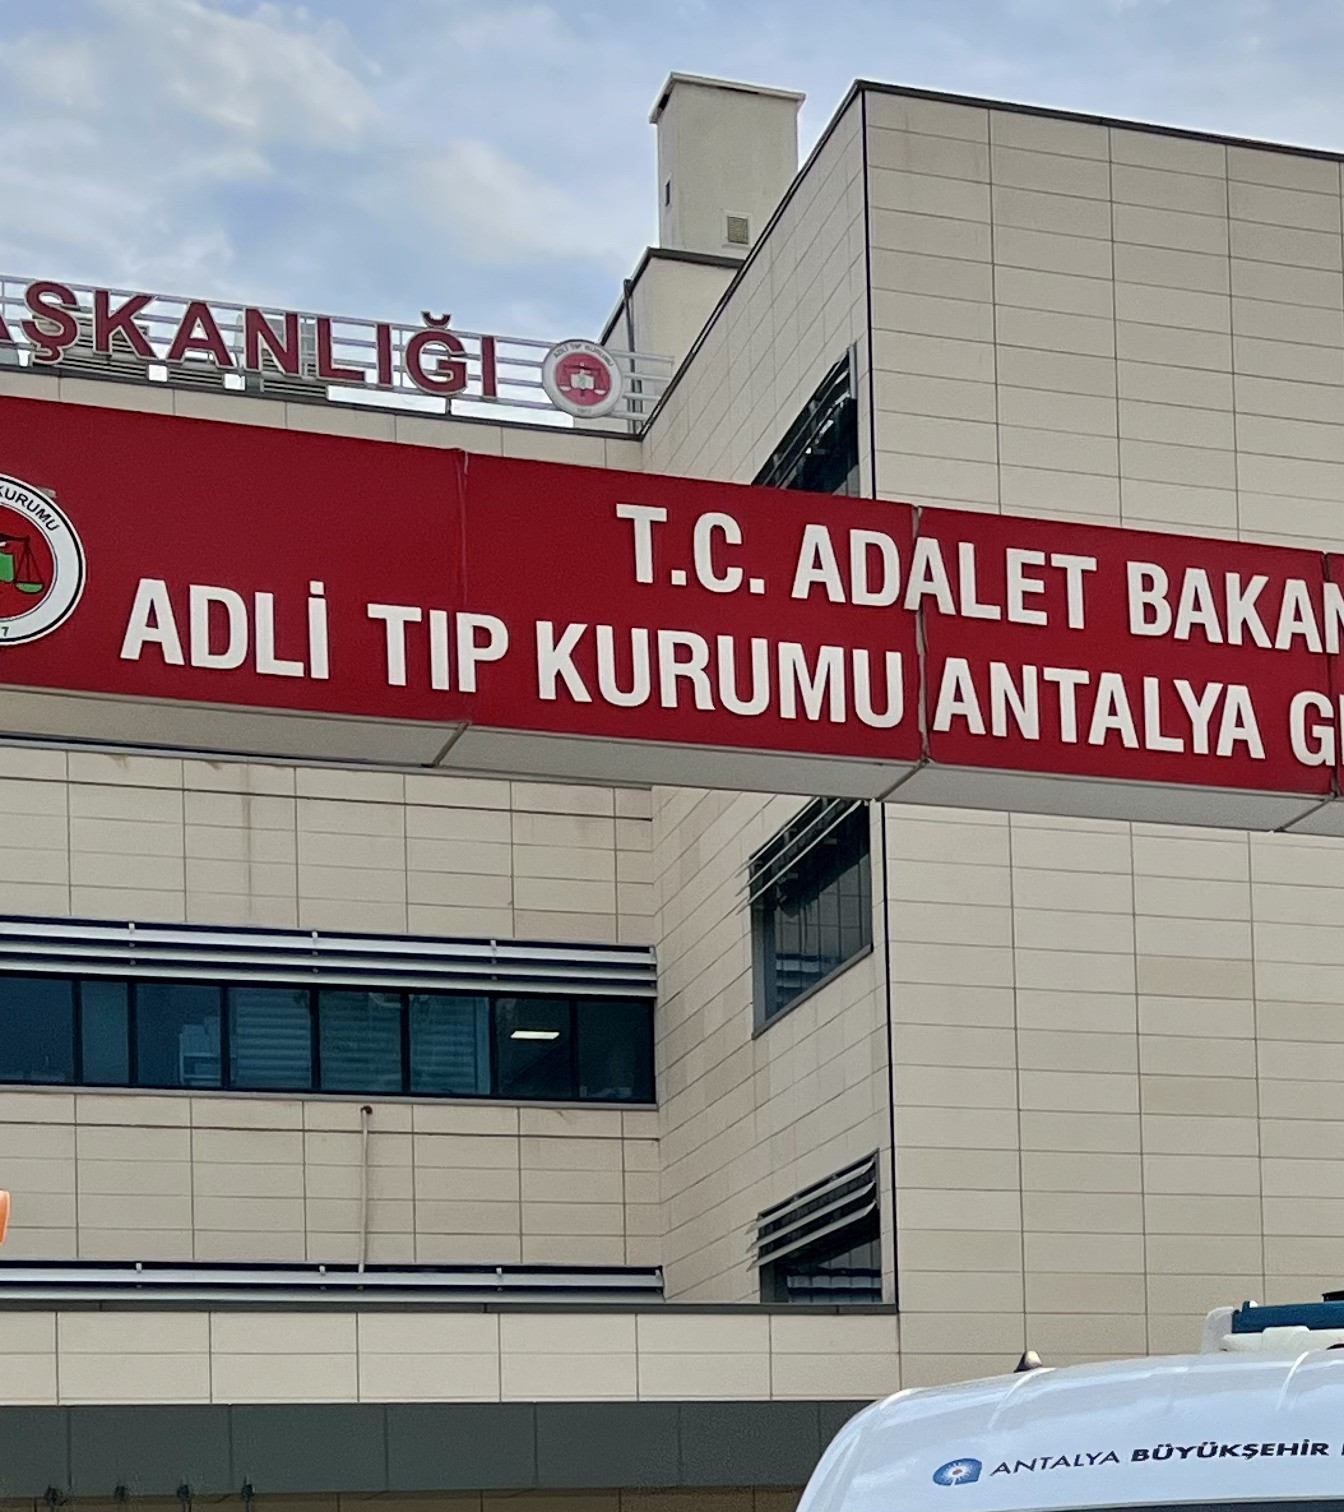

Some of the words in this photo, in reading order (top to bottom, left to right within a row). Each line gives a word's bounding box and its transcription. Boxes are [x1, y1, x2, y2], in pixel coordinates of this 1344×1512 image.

[616, 503, 766, 595] T.C.
[791, 524, 1098, 630] ADALET
[120, 577, 330, 682] ADLİ
[367, 603, 510, 692] TIP
[536, 619, 905, 730] KURUMU
[931, 656, 1266, 761] ANTALYA
[990, 1451, 1121, 1477] ANTALYA
[1131, 1438, 1330, 1463] BÜYÜKŞEHİR
